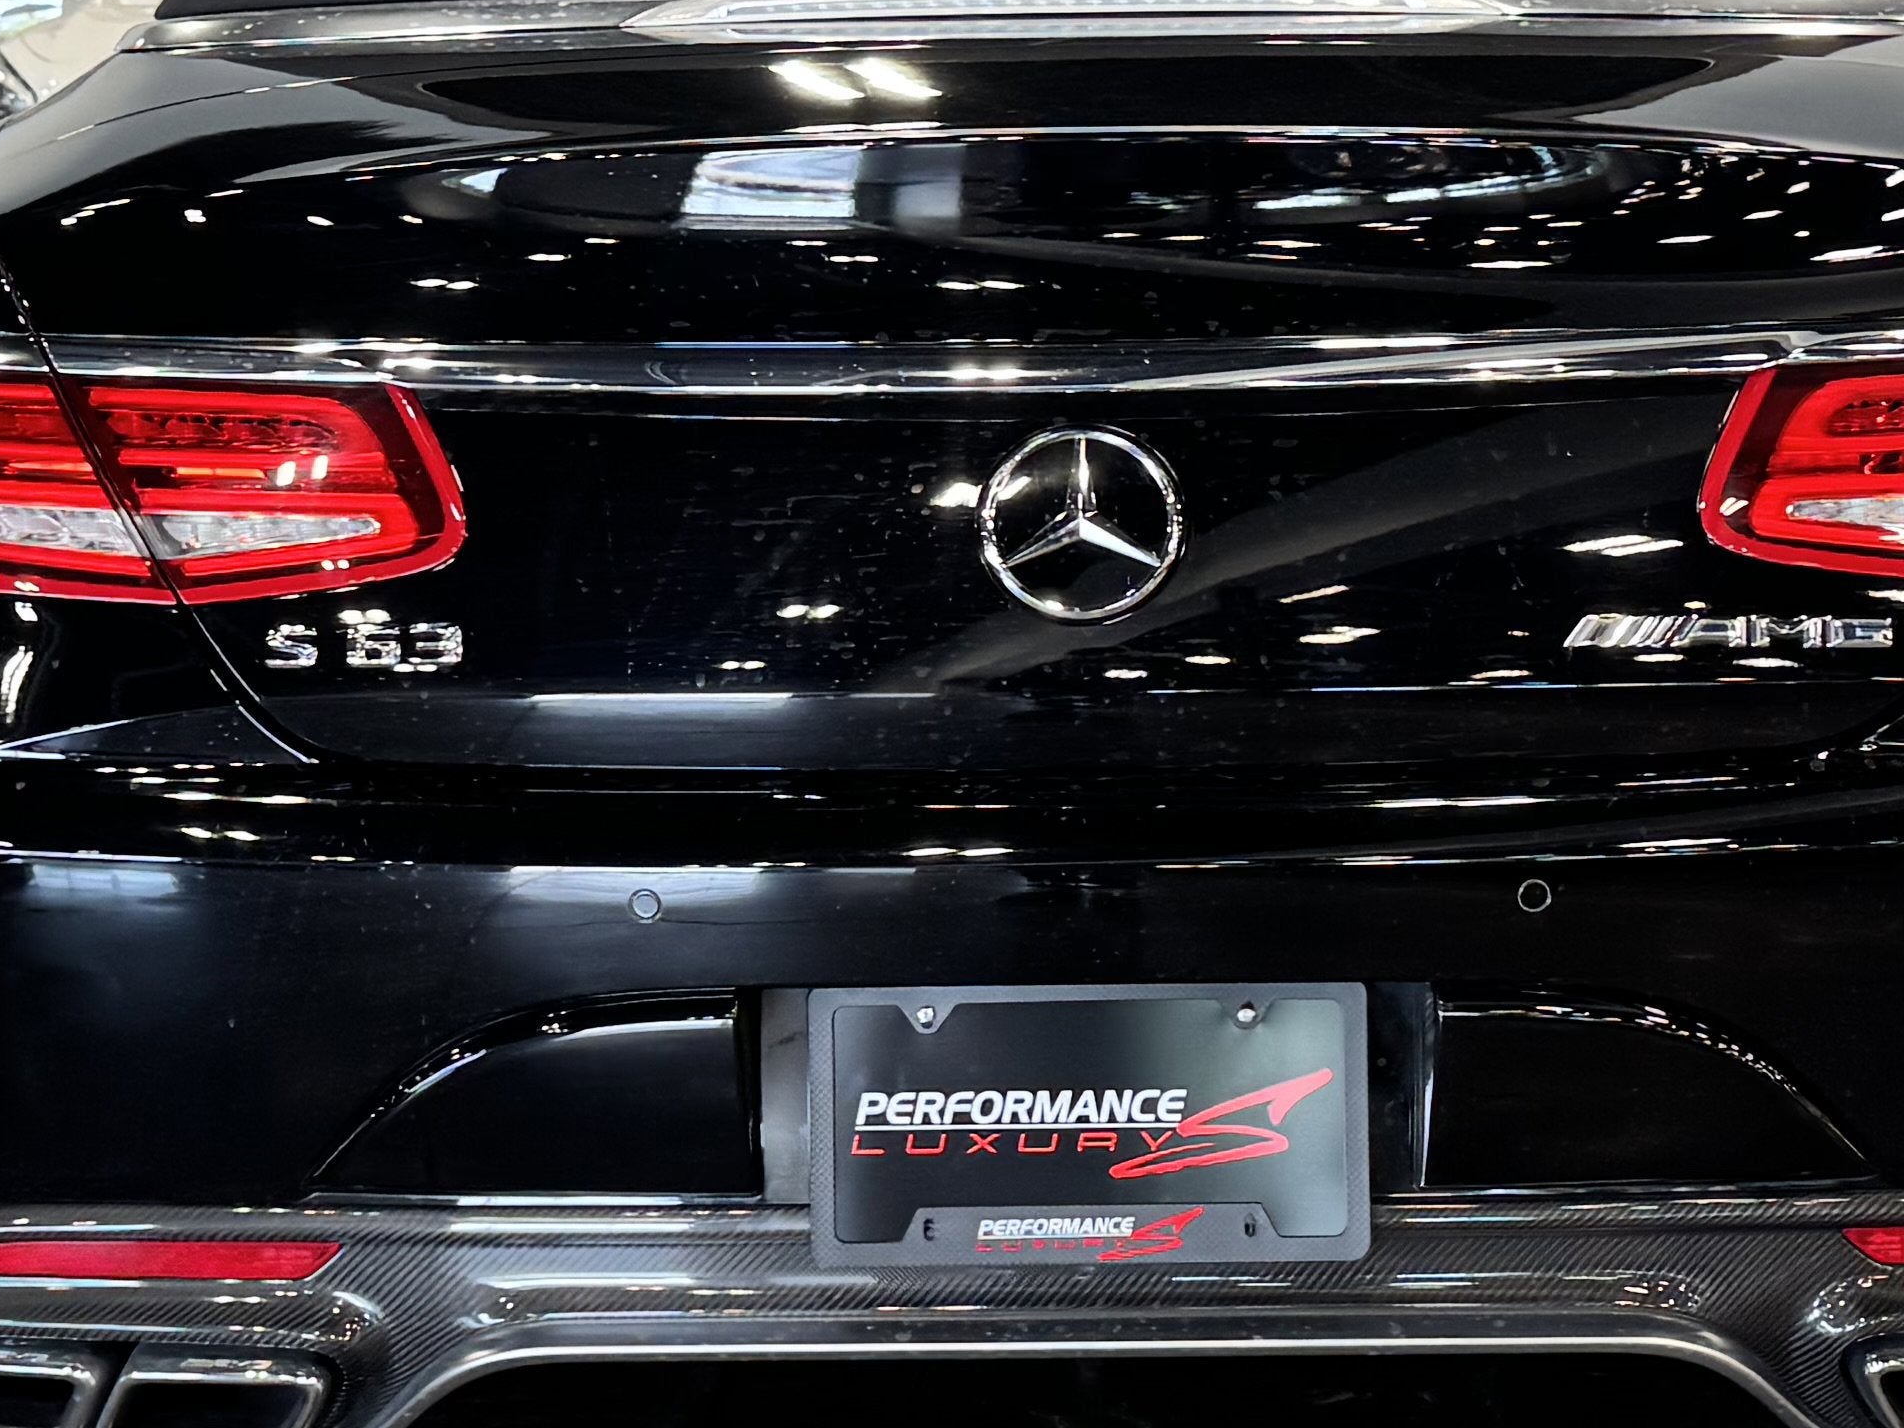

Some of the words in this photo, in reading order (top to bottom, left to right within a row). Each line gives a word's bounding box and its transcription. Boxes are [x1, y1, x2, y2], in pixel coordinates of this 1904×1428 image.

[856, 1088, 1188, 1126] PERFORMANCE
[850, 1131, 1175, 1155] LUXURY
[978, 1217, 1136, 1237] PERFORMANCE
